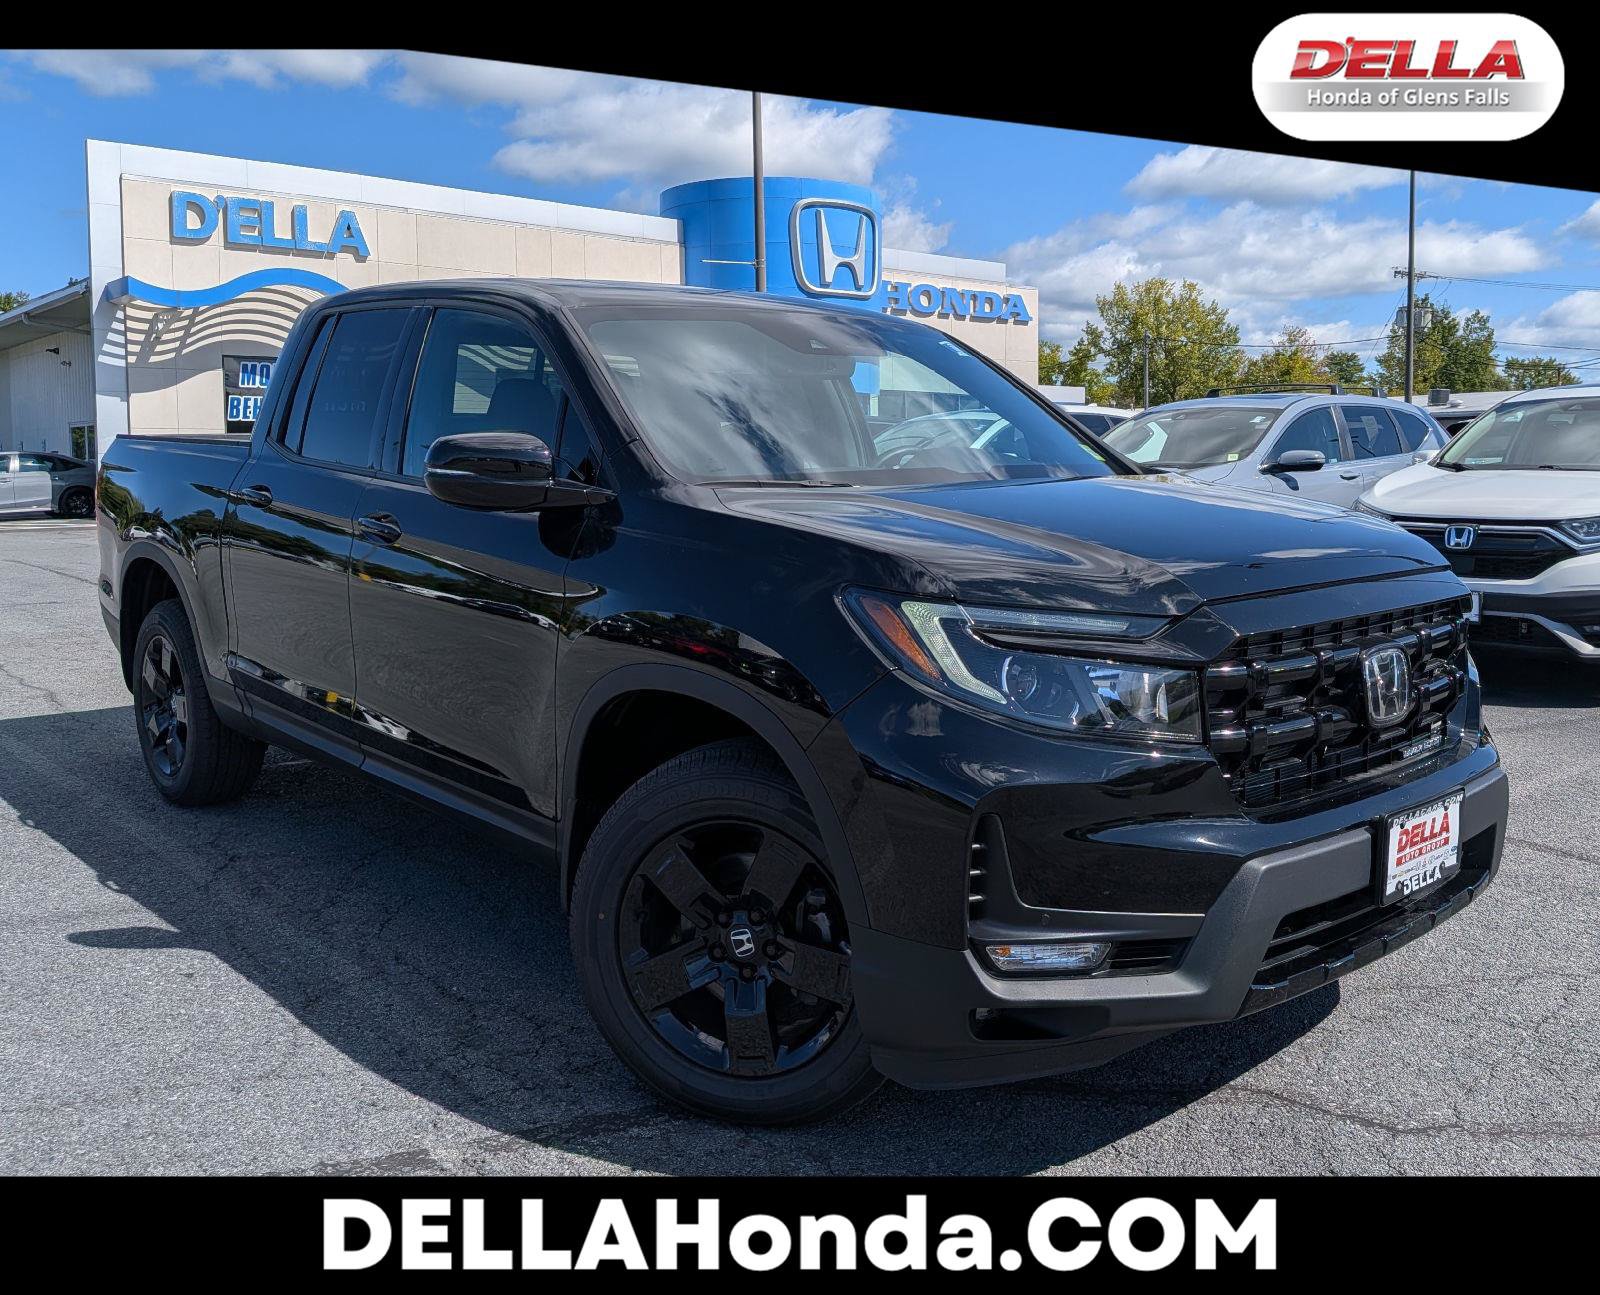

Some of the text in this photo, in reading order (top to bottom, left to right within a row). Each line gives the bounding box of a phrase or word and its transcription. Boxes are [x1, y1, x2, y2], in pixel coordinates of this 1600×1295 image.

[171, 190, 371, 257] D'ELLA
[882, 280, 1033, 323] HONDA
[239, 361, 277, 388] MO
[1401, 840, 1446, 864] AUTO GROUP
[1403, 866, 1442, 896] DELLA
